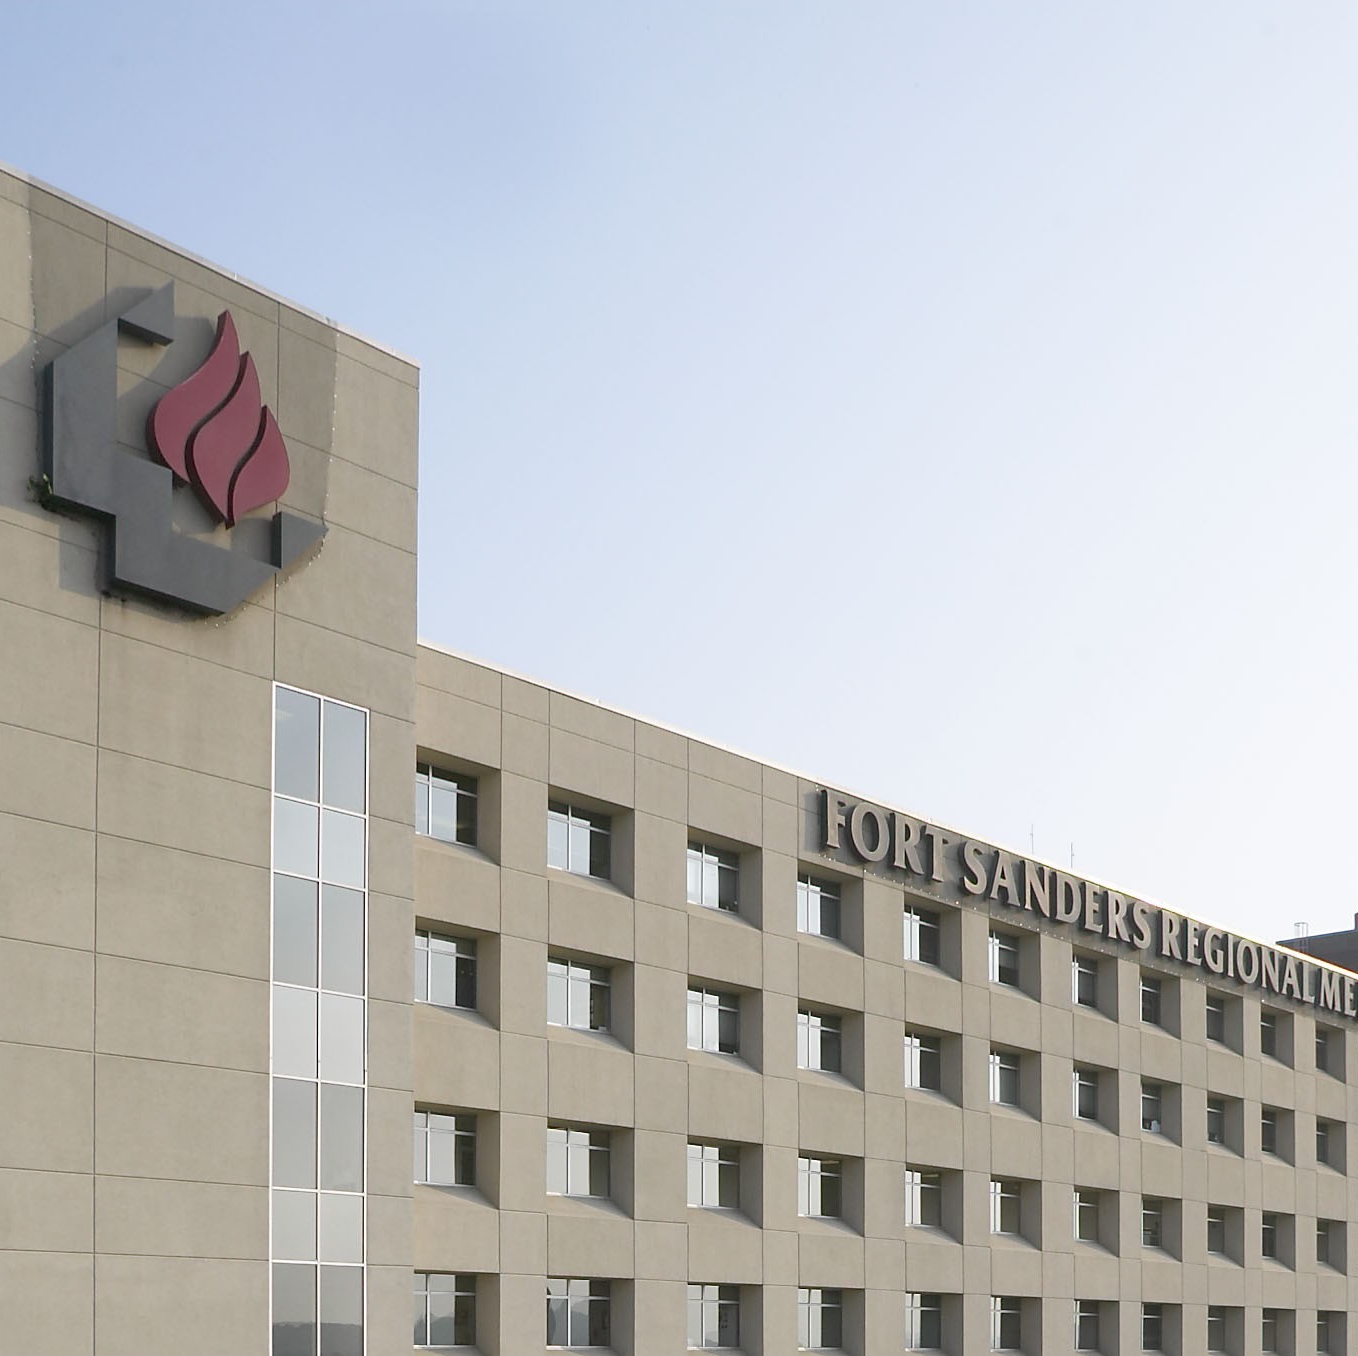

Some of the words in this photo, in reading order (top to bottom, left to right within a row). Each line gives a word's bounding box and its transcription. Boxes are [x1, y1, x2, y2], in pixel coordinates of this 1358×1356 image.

[820, 789, 947, 883] FORT
[960, 840, 1152, 950] SANDERS
[1159, 909, 1316, 1004] REGIONAL
